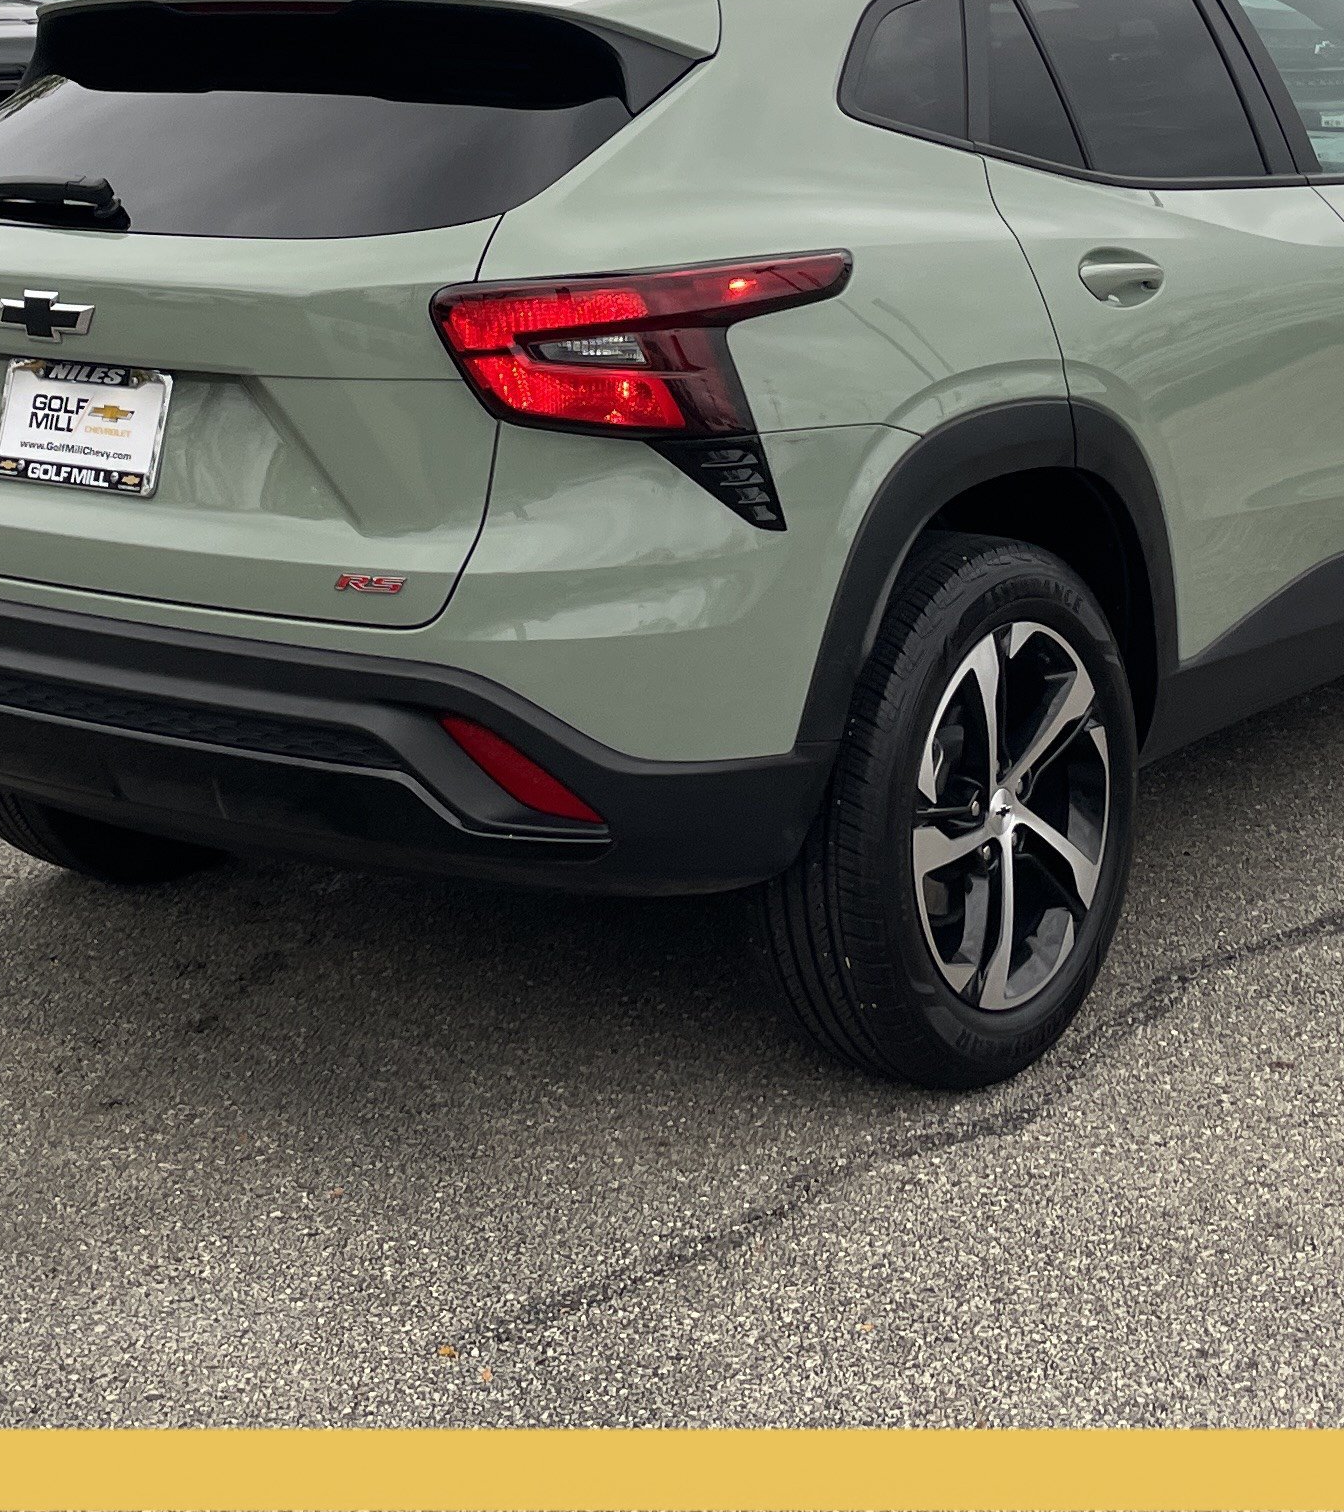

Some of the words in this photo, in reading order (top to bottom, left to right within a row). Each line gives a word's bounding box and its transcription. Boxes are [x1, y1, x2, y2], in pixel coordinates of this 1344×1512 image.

[49, 362, 125, 384] NILES
[33, 394, 89, 414] GOLF
[29, 413, 74, 432] MILL
[20, 441, 131, 460] www.GolfMillChevy.com
[28, 463, 69, 481] GOLF
[71, 468, 109, 487] MILL
[335, 573, 407, 594] RS
